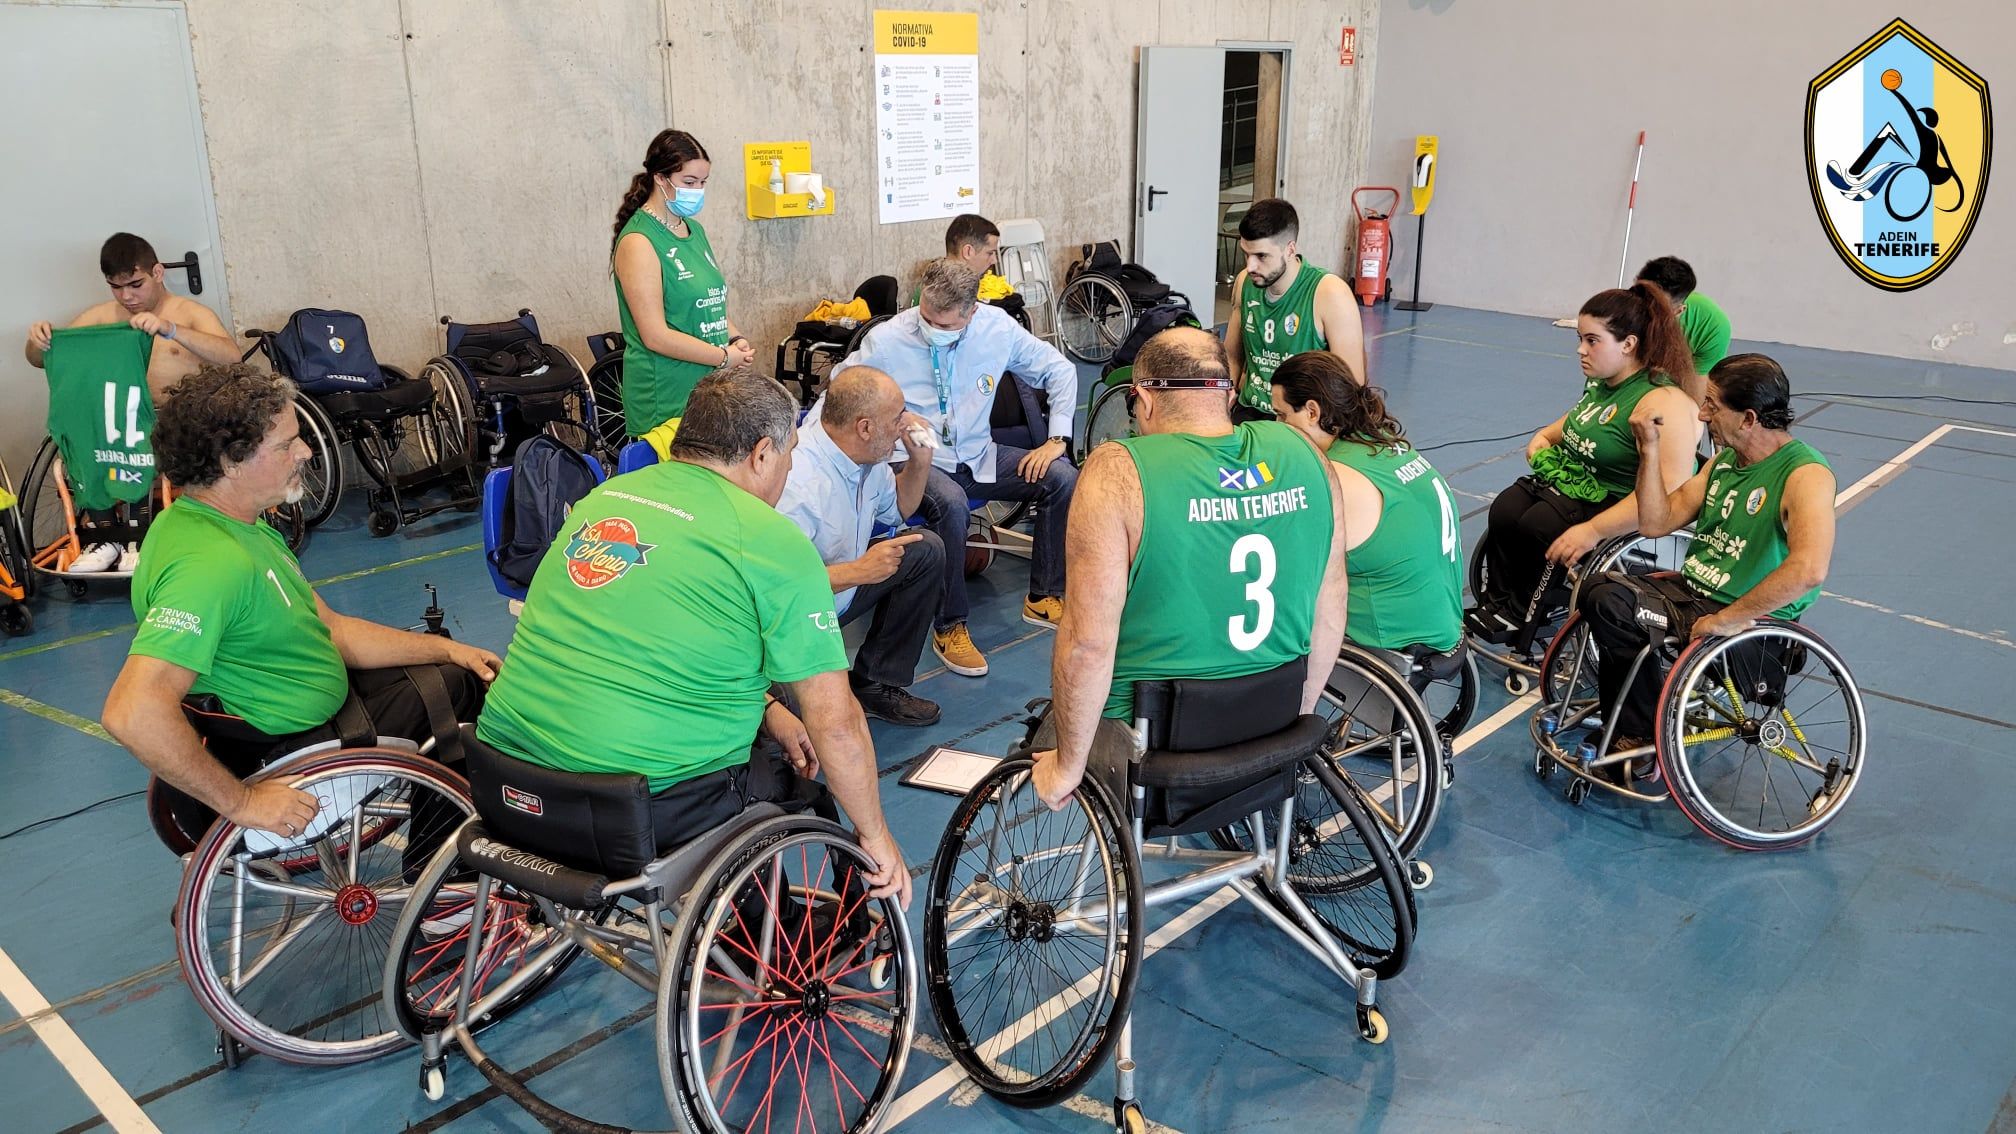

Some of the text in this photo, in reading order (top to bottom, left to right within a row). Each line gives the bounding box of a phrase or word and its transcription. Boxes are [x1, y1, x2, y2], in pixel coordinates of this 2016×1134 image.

[892, 23, 933, 35] NORMATIVA
[892, 36, 926, 47] COVID-19
[327, 325, 334, 334] 7
[1265, 319, 1275, 343] 8
[105, 382, 144, 448] 11
[1188, 486, 1309, 522] ADEIN TENERIFE
[1721, 489, 1738, 519] 5
[1432, 476, 1457, 563] 4
[574, 541, 628, 576] Mario
[1228, 533, 1277, 652] 3
[156, 615, 203, 637] CARMONA
